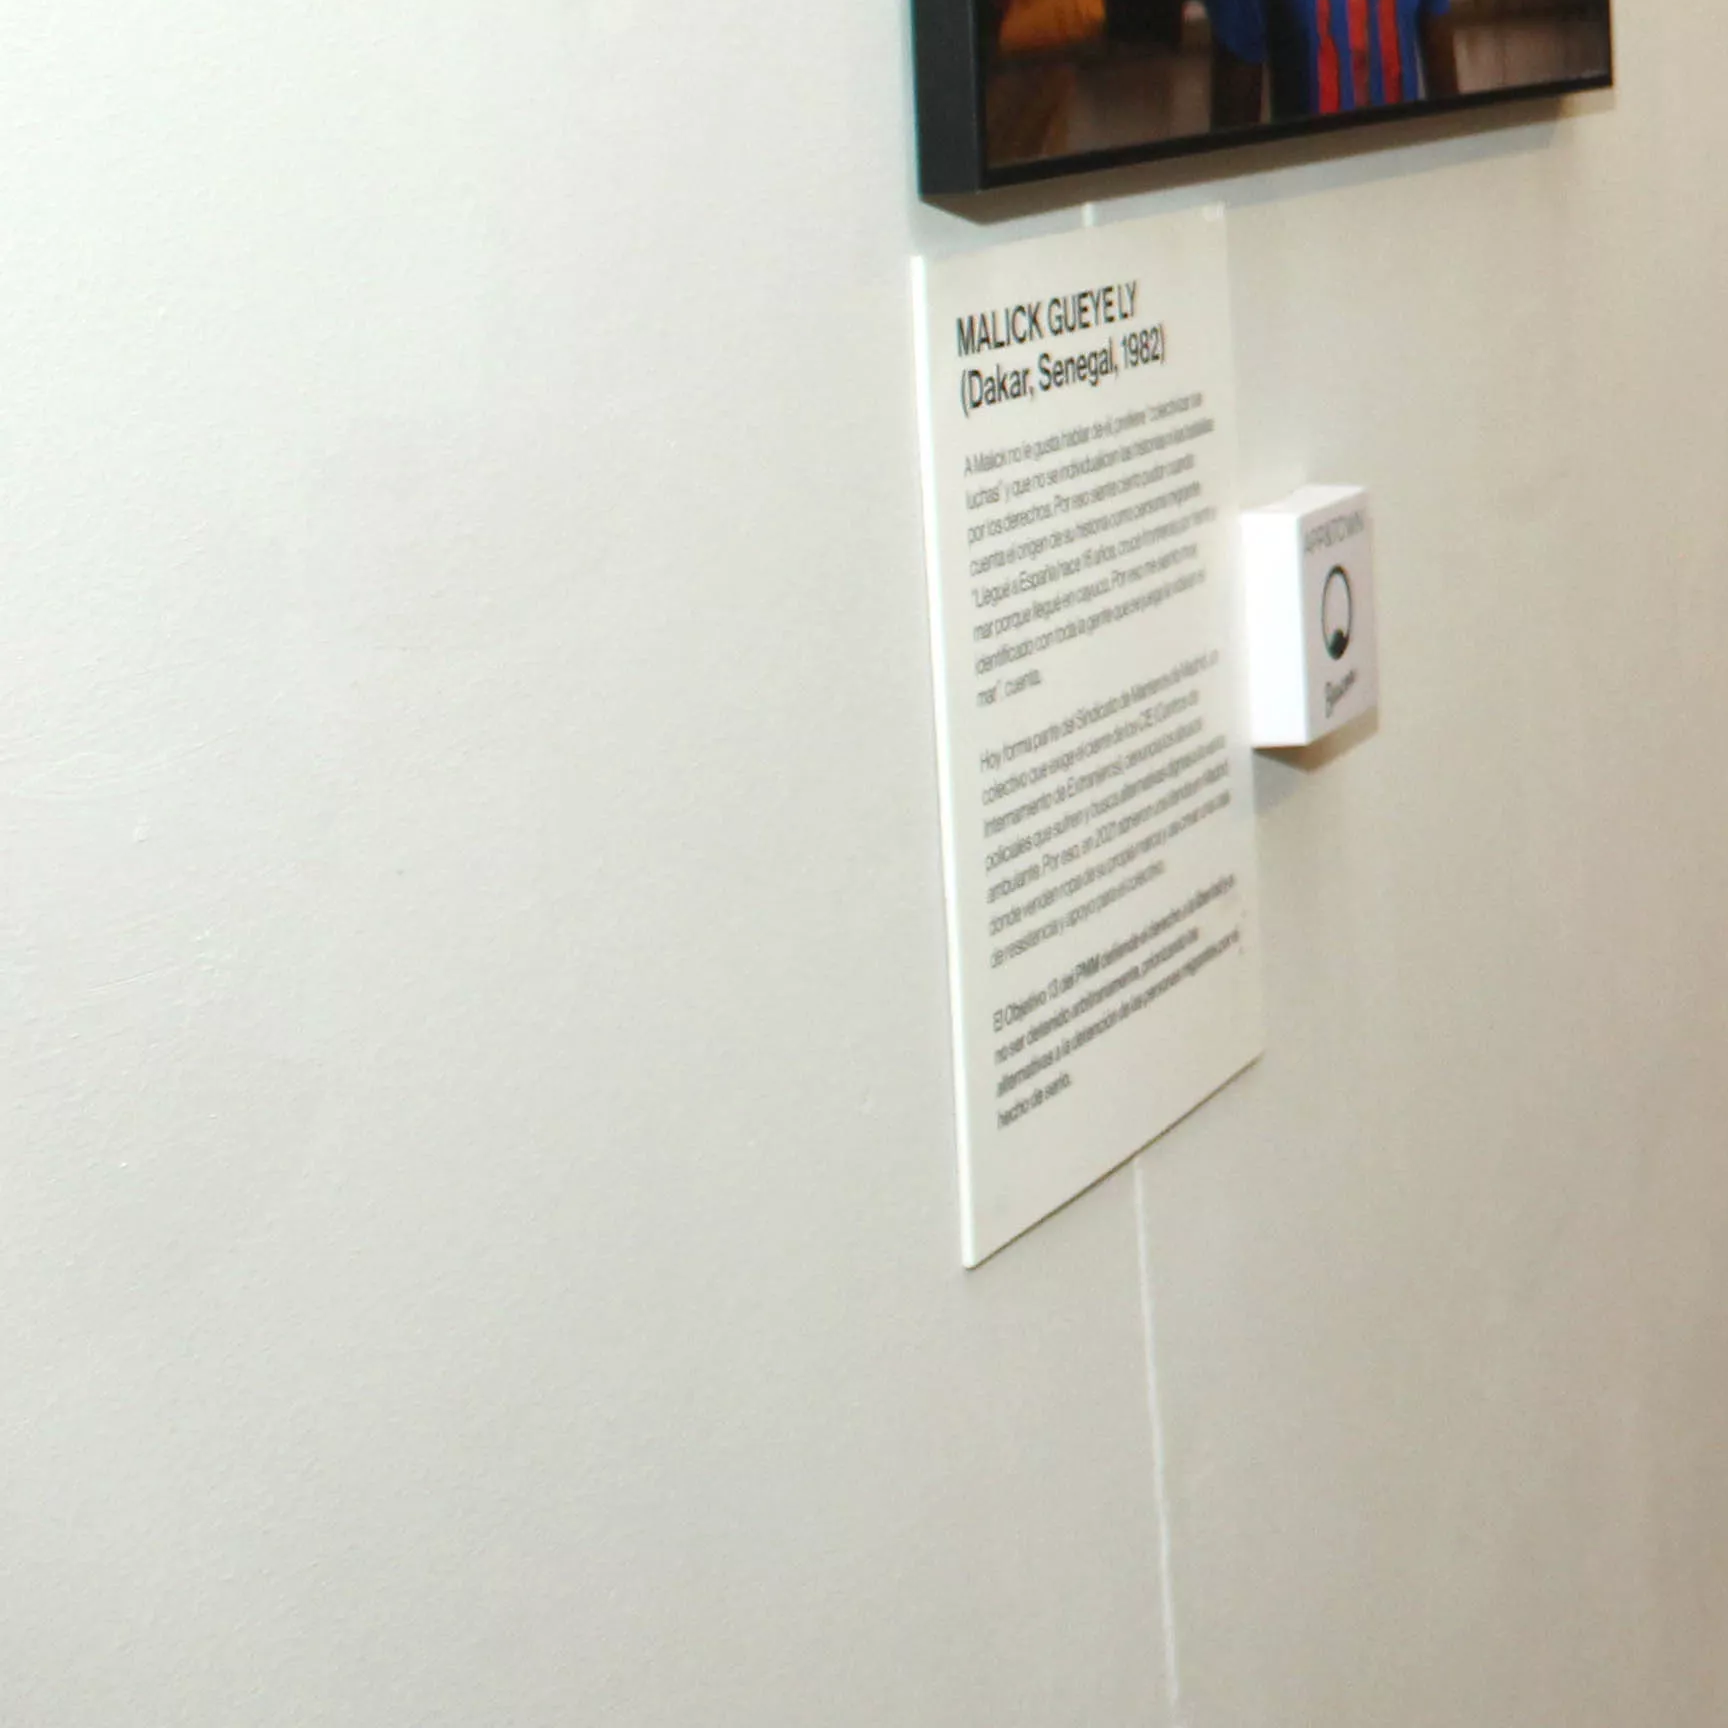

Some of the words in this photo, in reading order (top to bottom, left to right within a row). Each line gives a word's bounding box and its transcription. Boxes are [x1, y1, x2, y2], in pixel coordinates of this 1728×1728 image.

[956, 300, 1043, 356] MALICK
[1048, 286, 1115, 336] GUEYE
[1116, 280, 1138, 319] LY
[961, 366, 1034, 418] (Dakar,
[1038, 337, 1118, 392] Senegal,
[1121, 323, 1165, 368] 1982)
